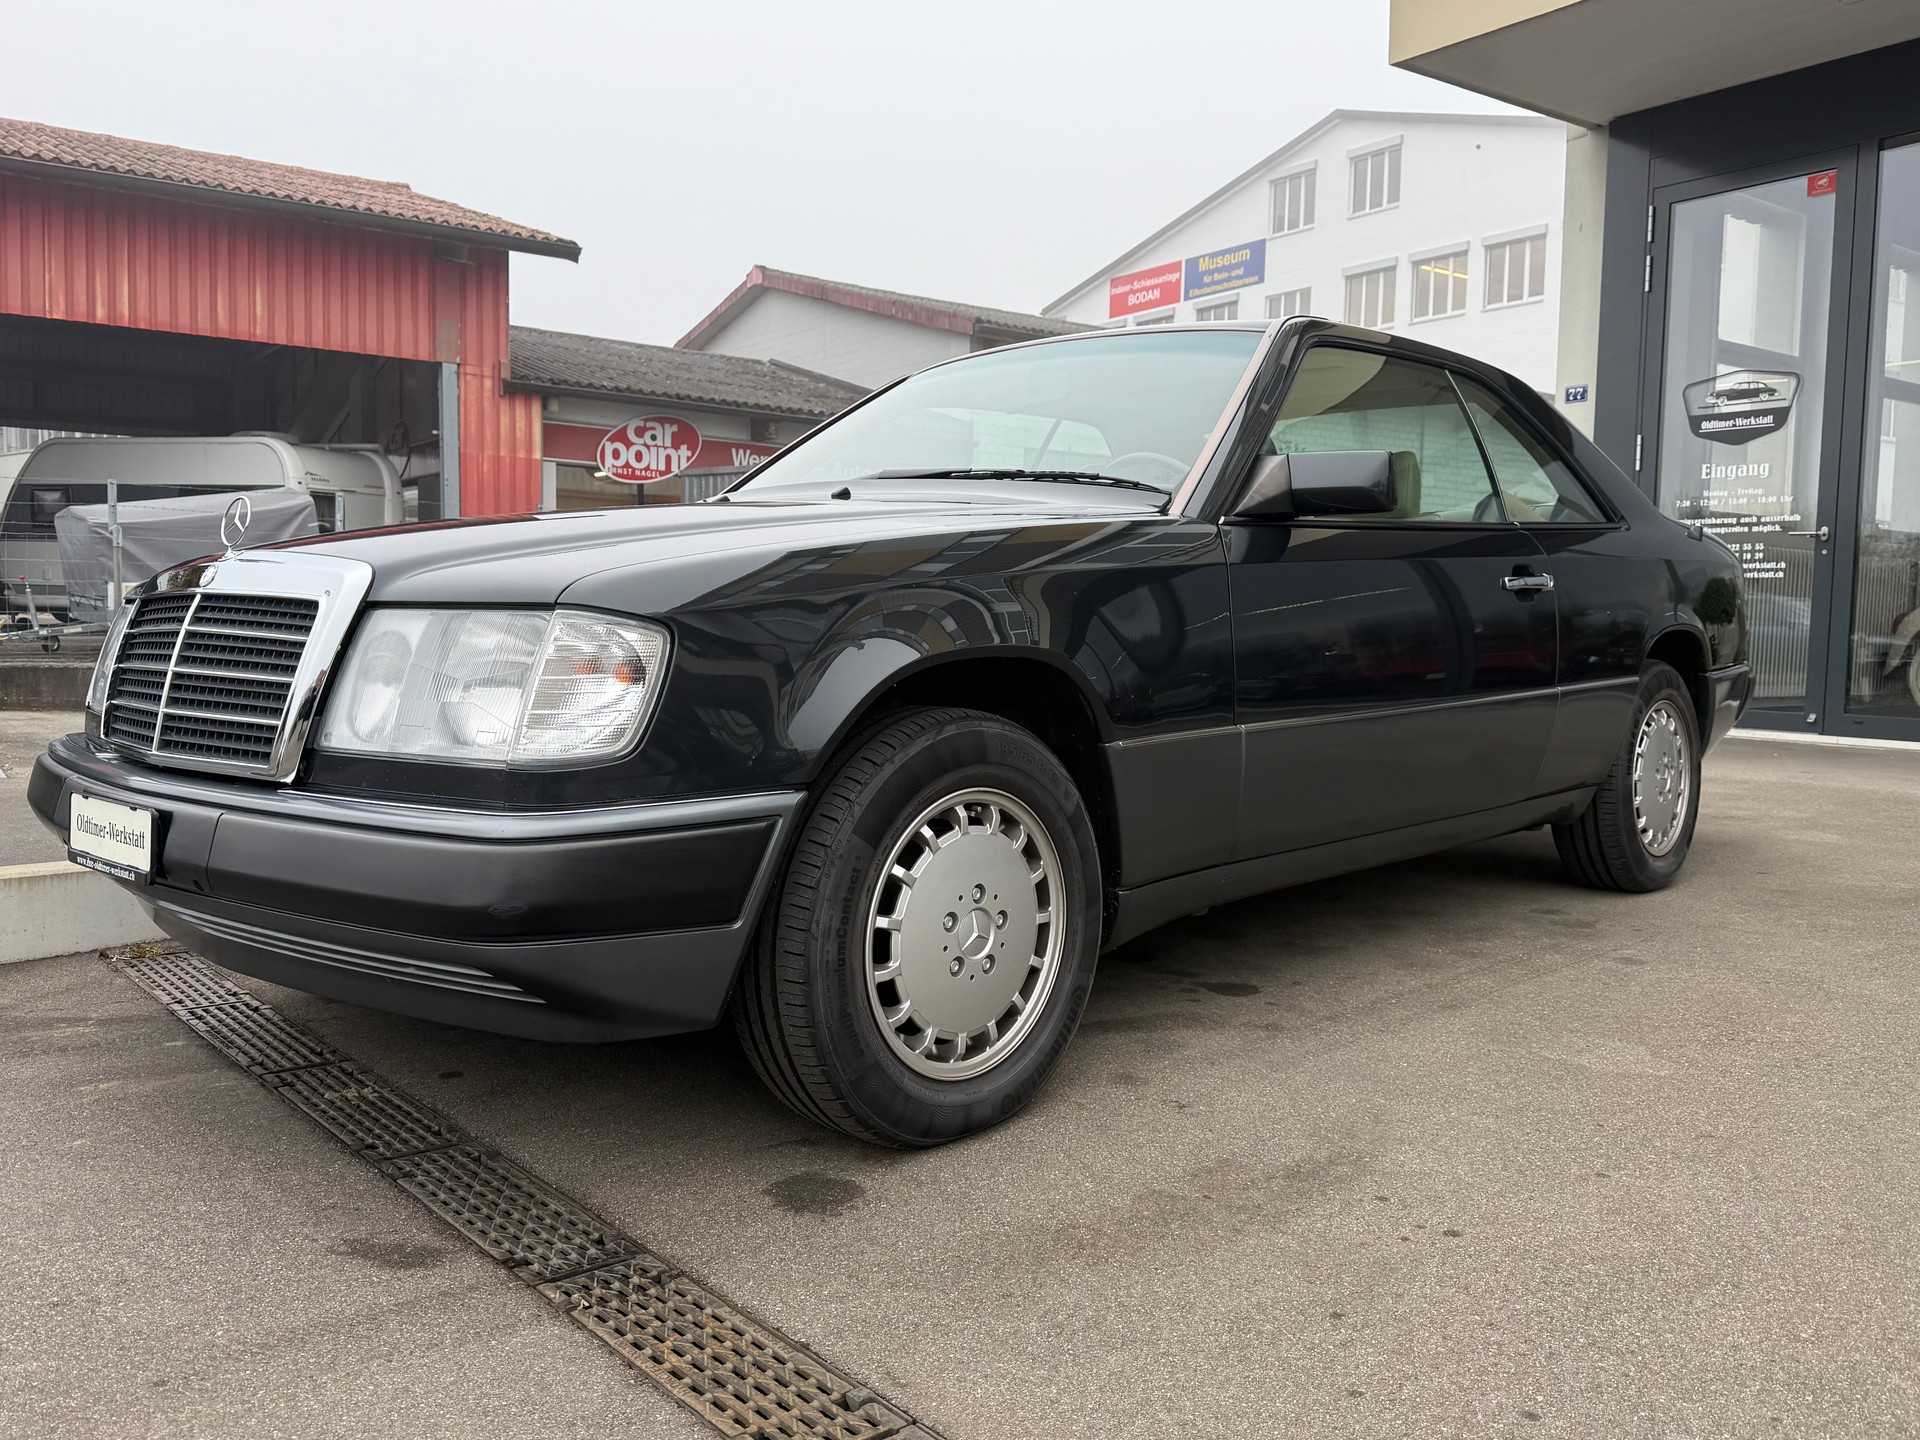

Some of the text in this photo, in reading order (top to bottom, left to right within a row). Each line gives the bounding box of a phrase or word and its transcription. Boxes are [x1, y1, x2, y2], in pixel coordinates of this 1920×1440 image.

[1199, 249, 1250, 272] Museum
[1128, 288, 1160, 306] BODAN
[1568, 388, 1583, 400] 77
[1701, 415, 1774, 430] Oldtimer-Werkstatt
[627, 419, 678, 447] car
[604, 441, 691, 471] point
[635, 469, 660, 477] NAGEL
[1701, 463, 1770, 480] Eingang
[1703, 489, 1728, 498] Montag
[1740, 515, 1758, 524] auch
[1760, 513, 1801, 523] ausserhalb
[1751, 524, 1783, 534] möglich.
[1755, 542, 1764, 550] 55
[77, 814, 145, 850] Oldtimer-Werkstatt
